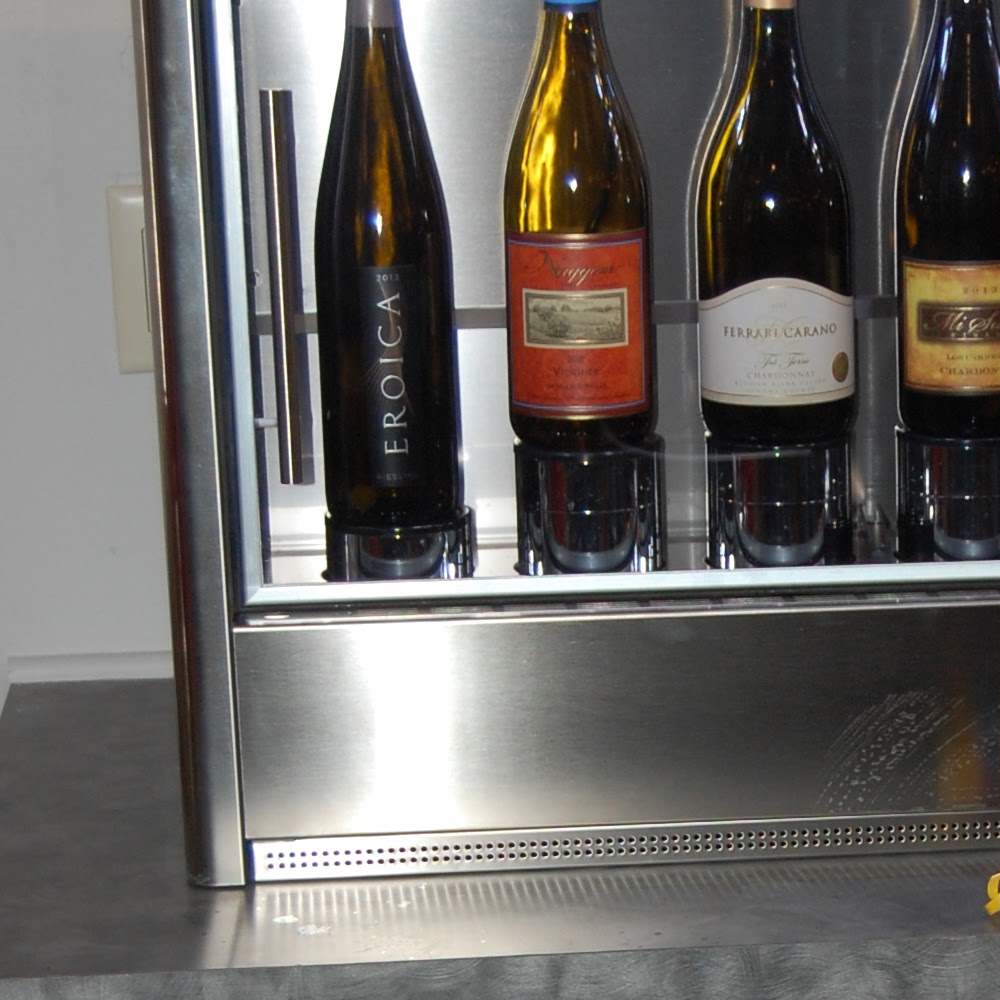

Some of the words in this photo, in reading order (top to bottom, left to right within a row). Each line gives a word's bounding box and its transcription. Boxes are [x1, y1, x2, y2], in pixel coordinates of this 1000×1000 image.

[376, 292, 409, 455] EROICA
[723, 325, 779, 339] FERRARI
[783, 322, 838, 339] CARANO
